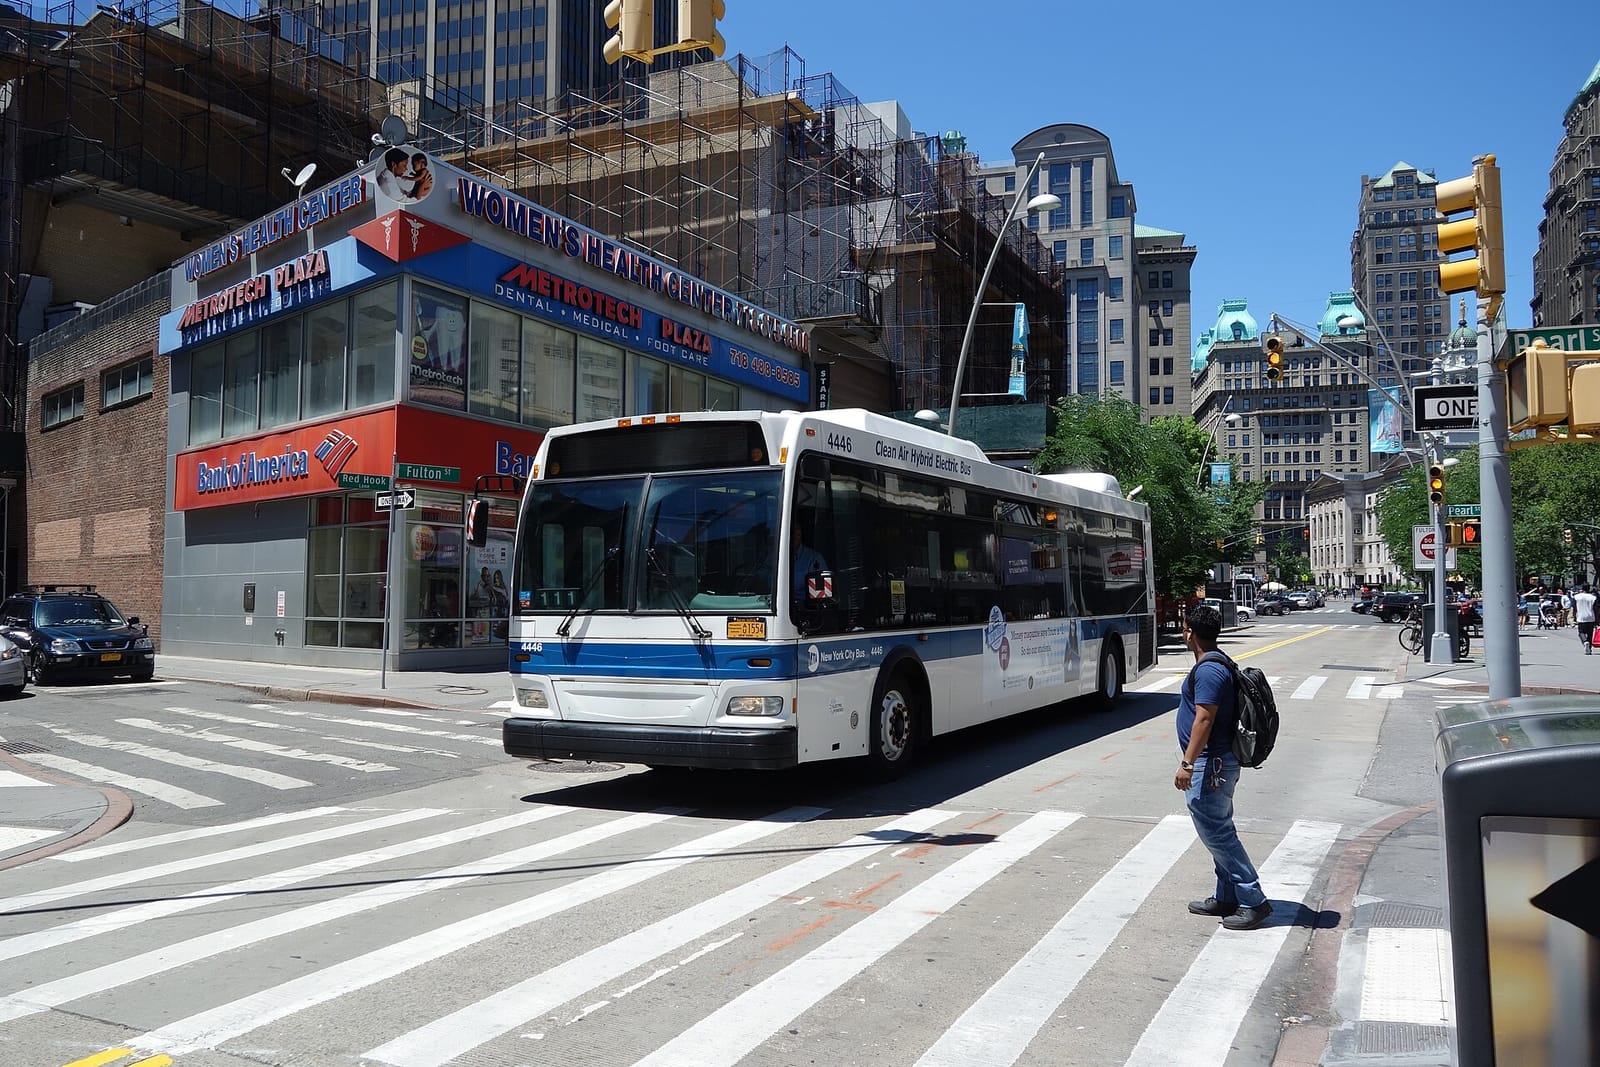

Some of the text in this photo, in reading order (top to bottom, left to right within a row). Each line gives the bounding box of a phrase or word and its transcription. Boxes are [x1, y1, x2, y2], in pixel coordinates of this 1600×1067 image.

[184, 175, 366, 282] WOMEN'S HEALTH CENTER
[458, 176, 581, 257] WOMEN'S
[583, 233, 663, 292] HEALTH
[664, 271, 734, 324] CENTER
[176, 275, 267, 330] METROTECH
[274, 250, 327, 291] PLAZA
[501, 263, 712, 354] METROTECH PLAZA
[495, 283, 708, 366] DENTAL MEDICAL FOOT CARE
[1592, 328, 1600, 342] S
[730, 347, 748, 369] 718
[1437, 400, 1478, 416] ONE
[827, 432, 971, 476] 4446 Clean Air Hybrid Electric Bus
[197, 444, 309, 492] Bank of America
[342, 473, 386, 485] Red Hook
[406, 466, 442, 480] Fulton
[1448, 506, 1473, 515] Pearl
[521, 642, 543, 652] 4446
[820, 652, 832, 662] New
[832, 650, 844, 660] York
[845, 649, 855, 661] City
[856, 648, 865, 658] Bus
